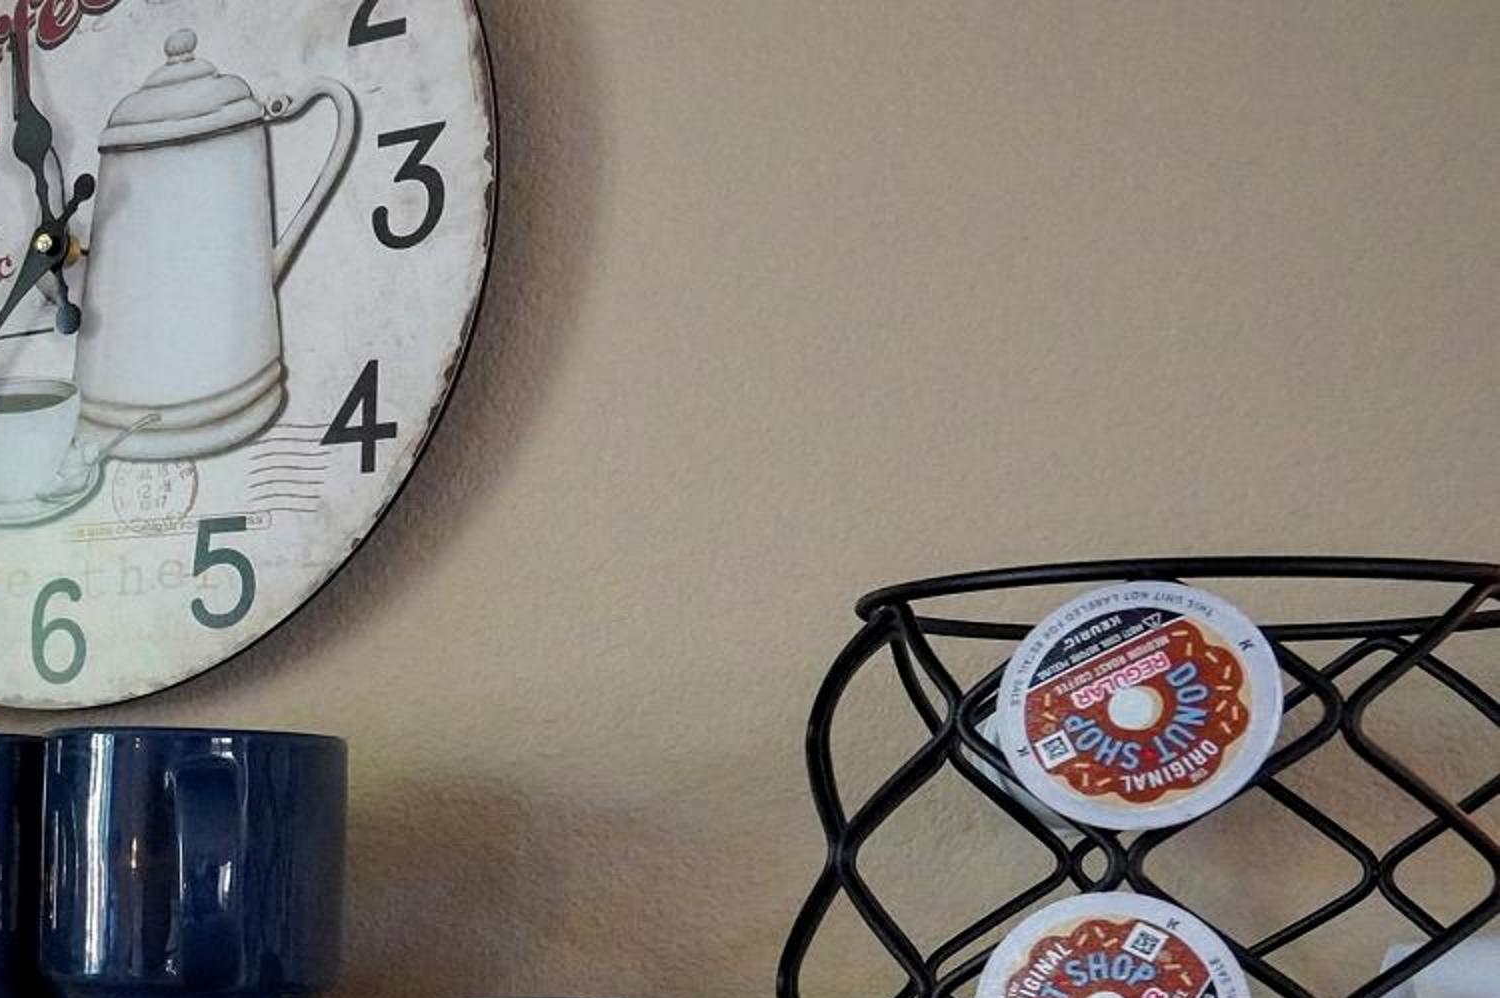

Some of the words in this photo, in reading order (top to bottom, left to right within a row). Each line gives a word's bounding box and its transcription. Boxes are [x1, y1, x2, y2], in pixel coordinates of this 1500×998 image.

[371, 121, 447, 250] 3
[320, 359, 398, 474] 4
[190, 516, 256, 629] 5
[31, 577, 87, 685] 6
[1063, 615, 1123, 651] KEURIG
[1071, 651, 1172, 709] REGULAR
[1150, 661, 1211, 765] DONUT
[1063, 713, 1142, 770] SHOP
[1120, 739, 1219, 793] ORIGINAL
[1064, 951, 1158, 987] SHOP
